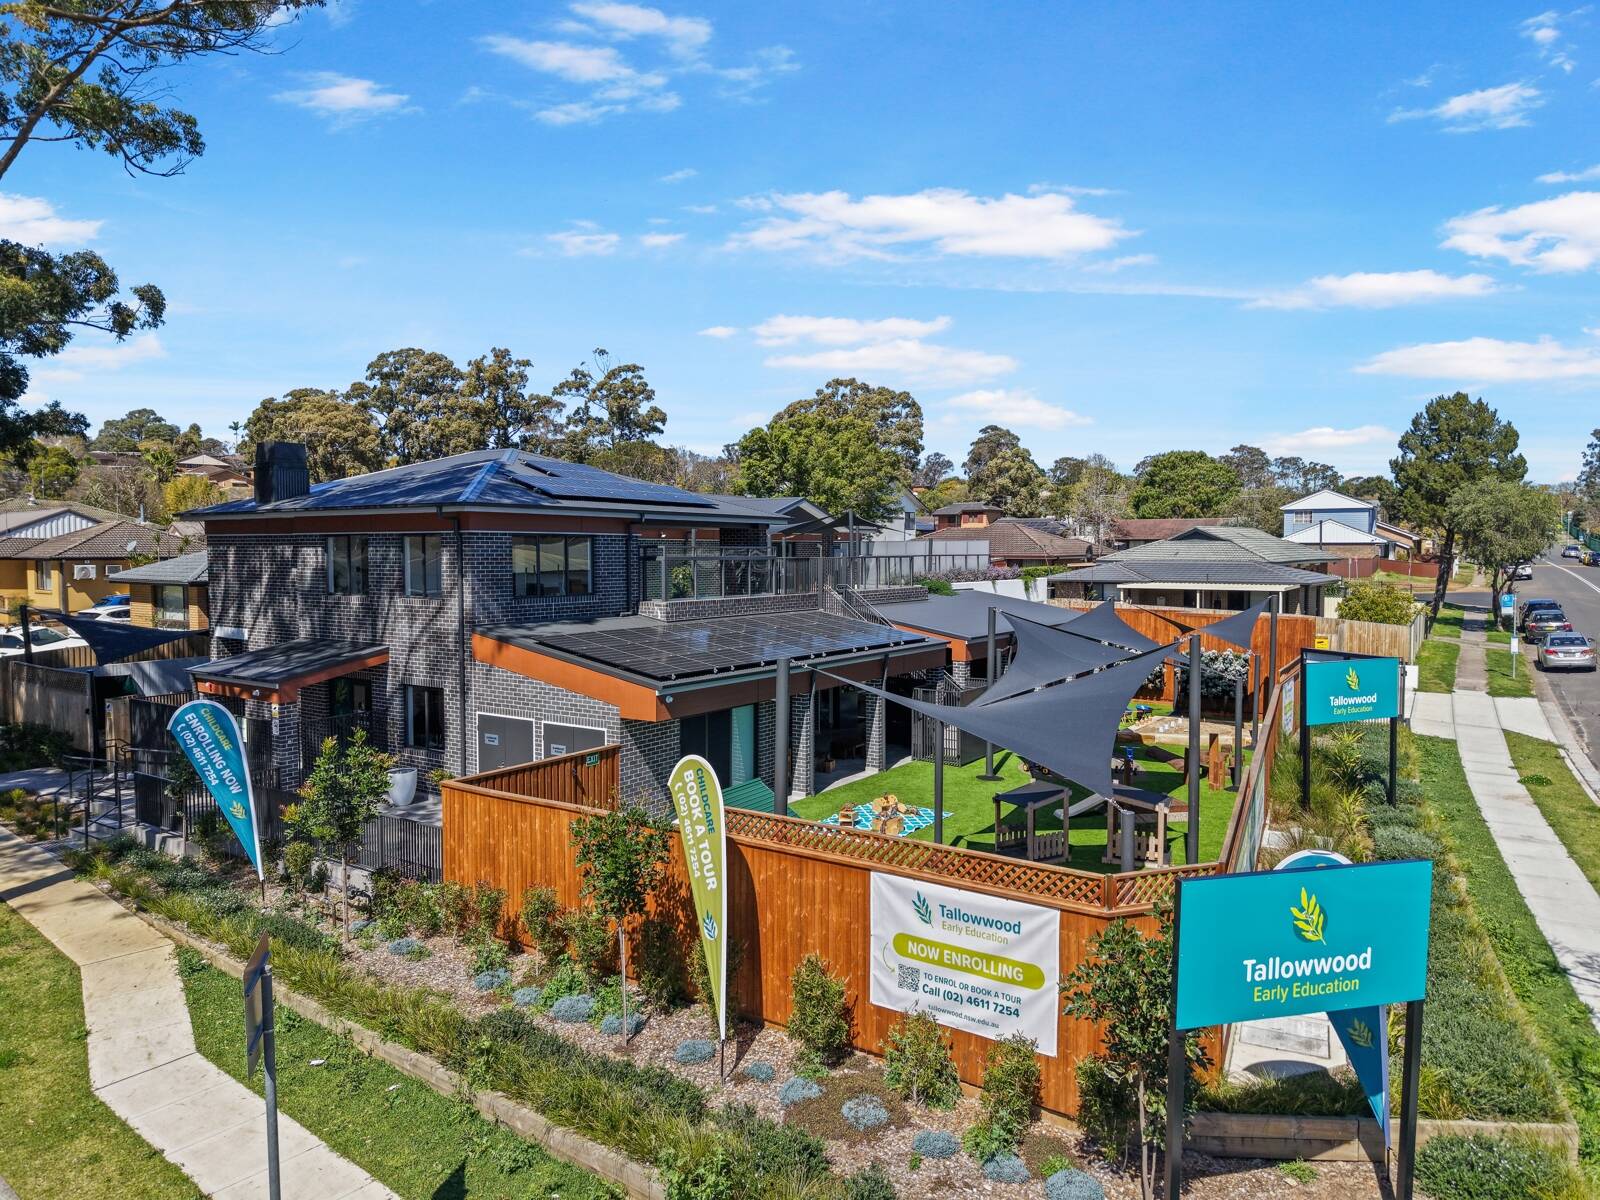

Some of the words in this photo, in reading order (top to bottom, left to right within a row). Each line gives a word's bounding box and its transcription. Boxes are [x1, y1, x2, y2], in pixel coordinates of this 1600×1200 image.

[1329, 693, 1377, 706] Tallowwood
[1333, 707, 1347, 716] Early
[1348, 705, 1373, 714] Education
[201, 708, 233, 751] CHILDCARE
[181, 730, 195, 748] (02)
[192, 746, 206, 765] 4611
[203, 764, 219, 786] 7254
[185, 713, 227, 770] ENROLLING
[220, 768, 242, 794] NOW
[586, 754, 598, 763] EXIT
[684, 770, 703, 820] BOOK
[696, 768, 715, 834] CHILDCARE
[695, 825, 705, 837] A
[698, 840, 718, 891] TOUR
[939, 903, 1021, 935] Tallowwood
[942, 921, 964, 935] Early
[965, 926, 1009, 945] Education
[908, 940, 940, 961] NOW
[943, 951, 1024, 981] ENROLLING
[1243, 947, 1372, 982] Tallowwood
[922, 984, 940, 998] Call
[943, 989, 963, 1004] (02)
[966, 996, 990, 1011] 4611
[993, 1003, 1020, 1017] 7254
[924, 972, 933, 982] TO
[935, 975, 957, 988] ENROL
[959, 982, 969, 992] OR
[971, 985, 992, 997] BOOK
[1001, 992, 1022, 1005] TOUR
[1253, 985, 1289, 1003] Early
[1292, 977, 1359, 998] Education
[928, 1004, 999, 1029] tallowwood.nsw.edu.au
